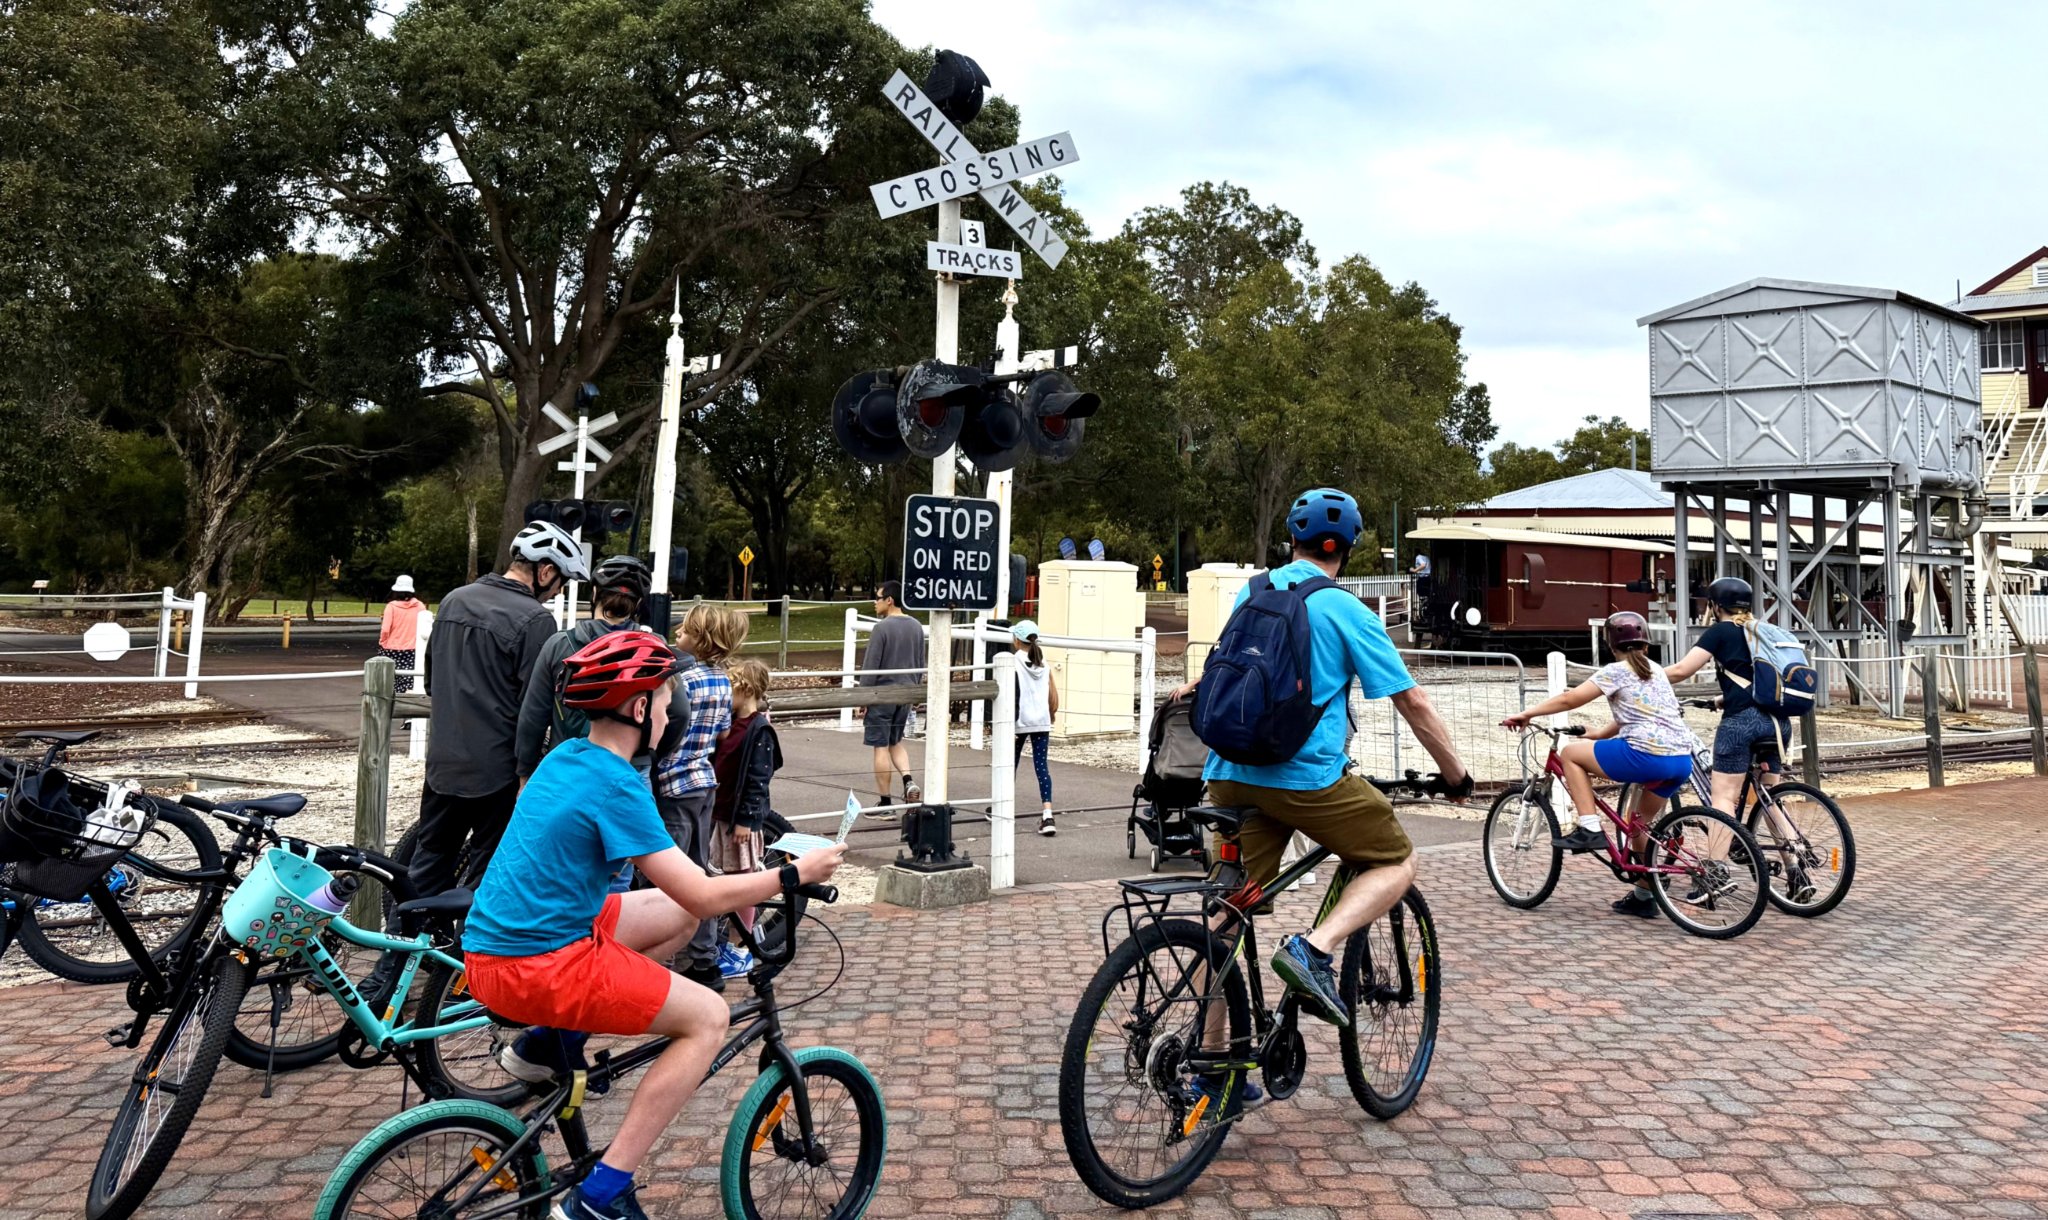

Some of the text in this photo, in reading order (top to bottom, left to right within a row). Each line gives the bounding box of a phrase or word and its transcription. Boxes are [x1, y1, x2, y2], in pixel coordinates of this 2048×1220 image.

[889, 139, 1065, 209] CROSSING
[894, 83, 1059, 253] RAIL WAY
[967, 227, 980, 244] 3
[936, 248, 1014, 273] TRACKS
[914, 505, 993, 540] STOP
[914, 548, 991, 571] ON RED
[914, 577, 988, 600] SIGNAL
